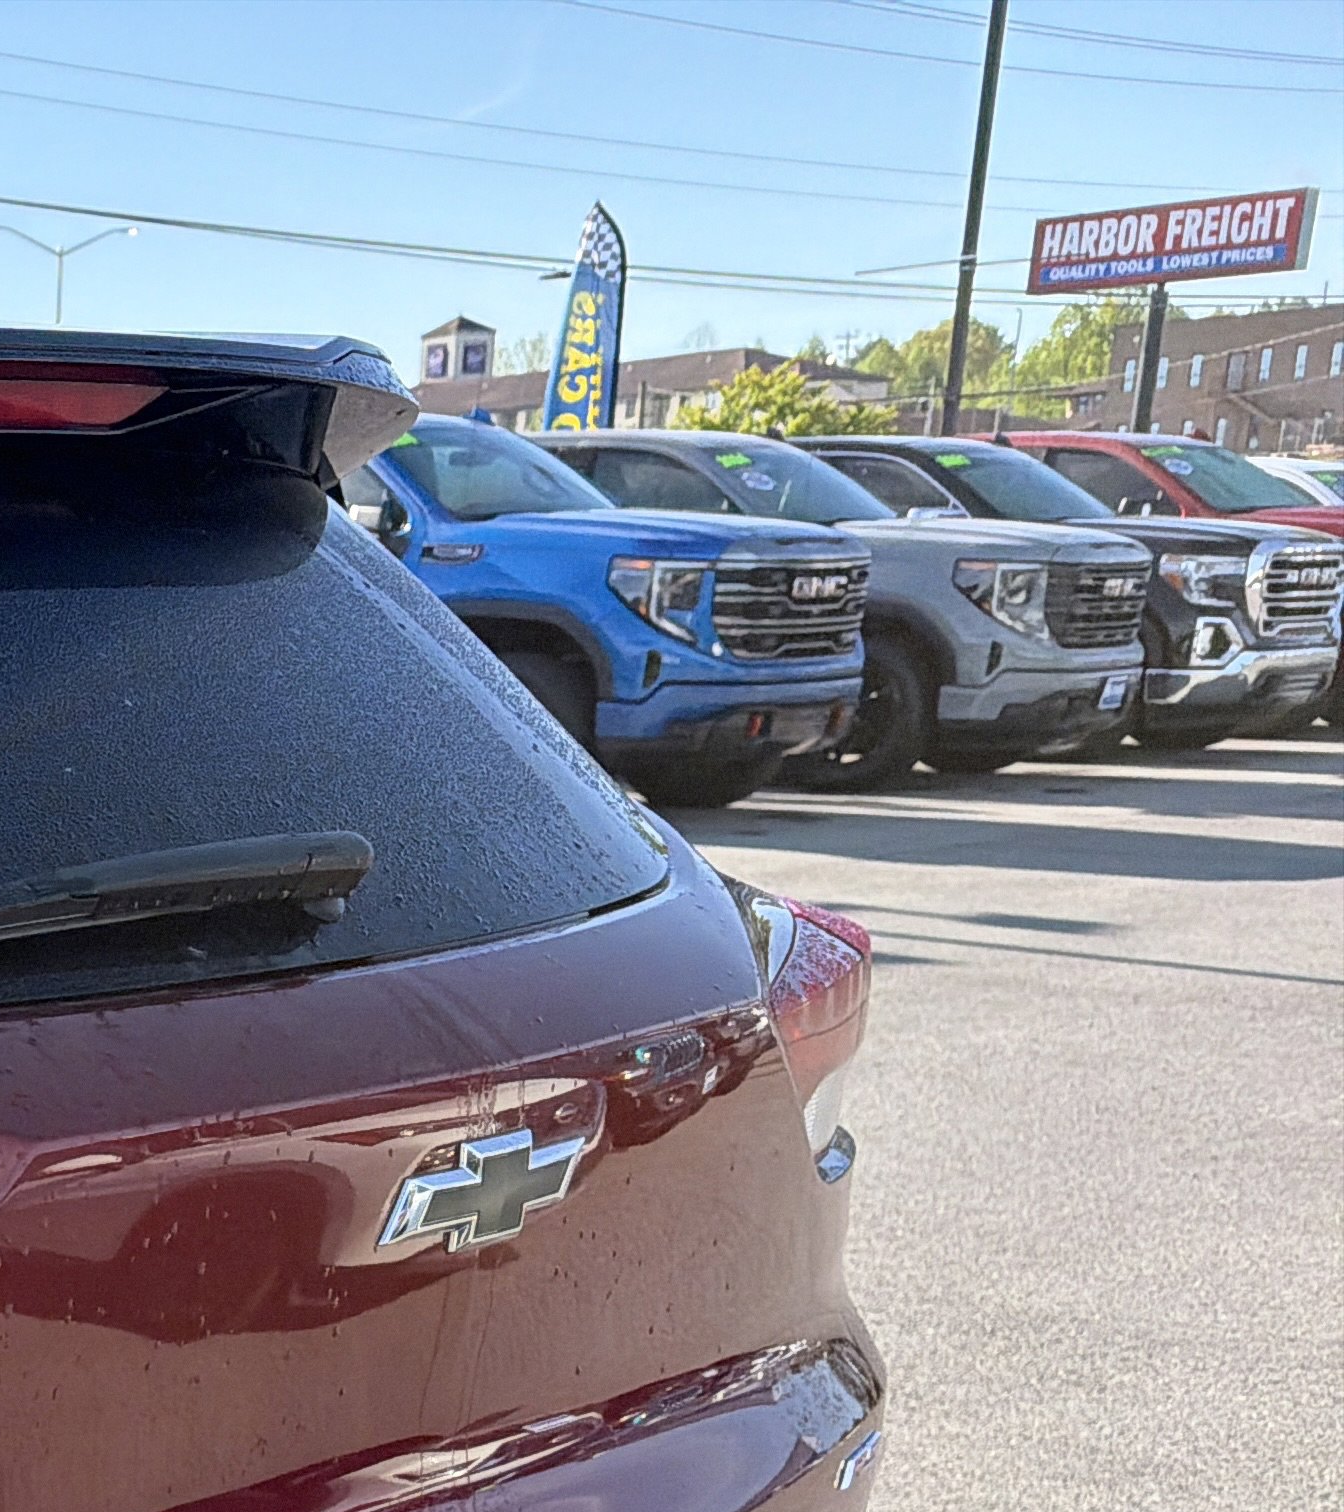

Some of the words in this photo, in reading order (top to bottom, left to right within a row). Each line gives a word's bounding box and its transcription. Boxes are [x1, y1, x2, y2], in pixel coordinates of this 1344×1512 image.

[1040, 213, 1158, 263] HARBOR
[1164, 197, 1296, 251] FREIGHT
[1049, 262, 1109, 281] QUALITY
[1109, 256, 1155, 275] TOOLS
[1161, 250, 1220, 271] LOWEST
[1220, 245, 1275, 265] PRICES
